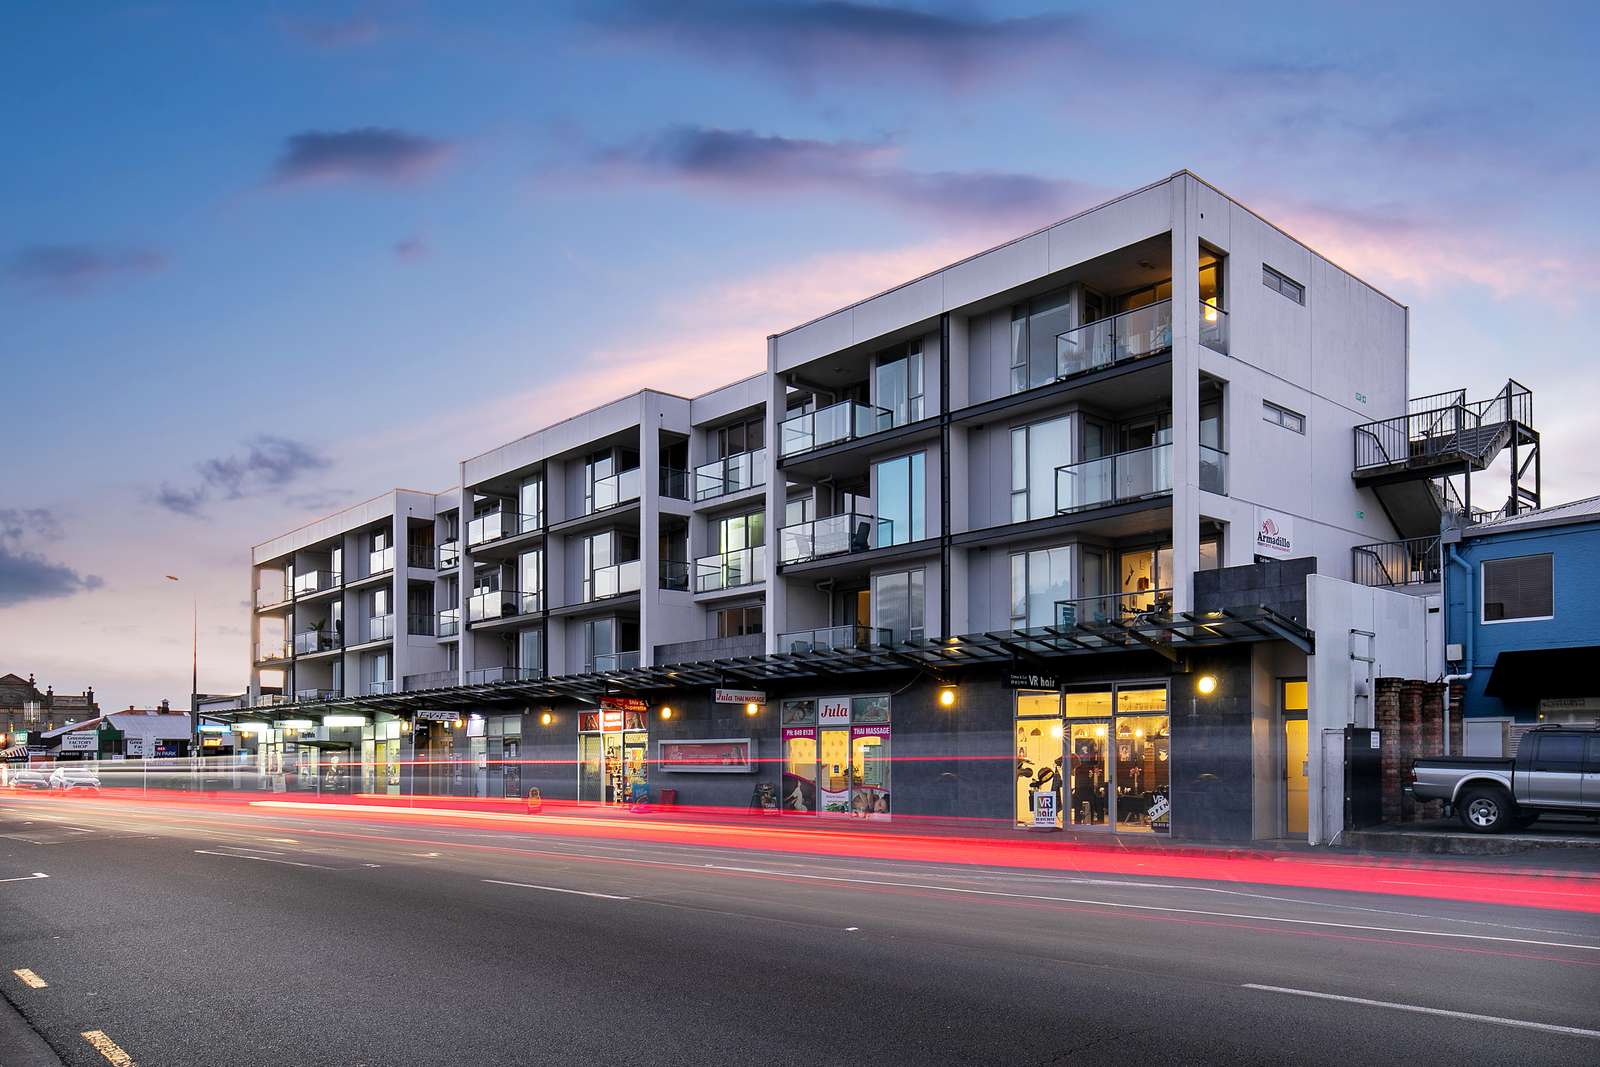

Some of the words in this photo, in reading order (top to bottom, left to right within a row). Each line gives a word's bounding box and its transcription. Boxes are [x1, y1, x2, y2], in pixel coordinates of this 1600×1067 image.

[1257, 531, 1290, 548] Armadillo
[1029, 675, 1038, 686] VR
[1040, 676, 1055, 687] hair
[821, 704, 848, 718] Jula
[866, 727, 890, 735] MASSAGE
[1040, 797, 1051, 808] VR
[1037, 808, 1053, 817] hair
[1150, 801, 1169, 817] OPEN
